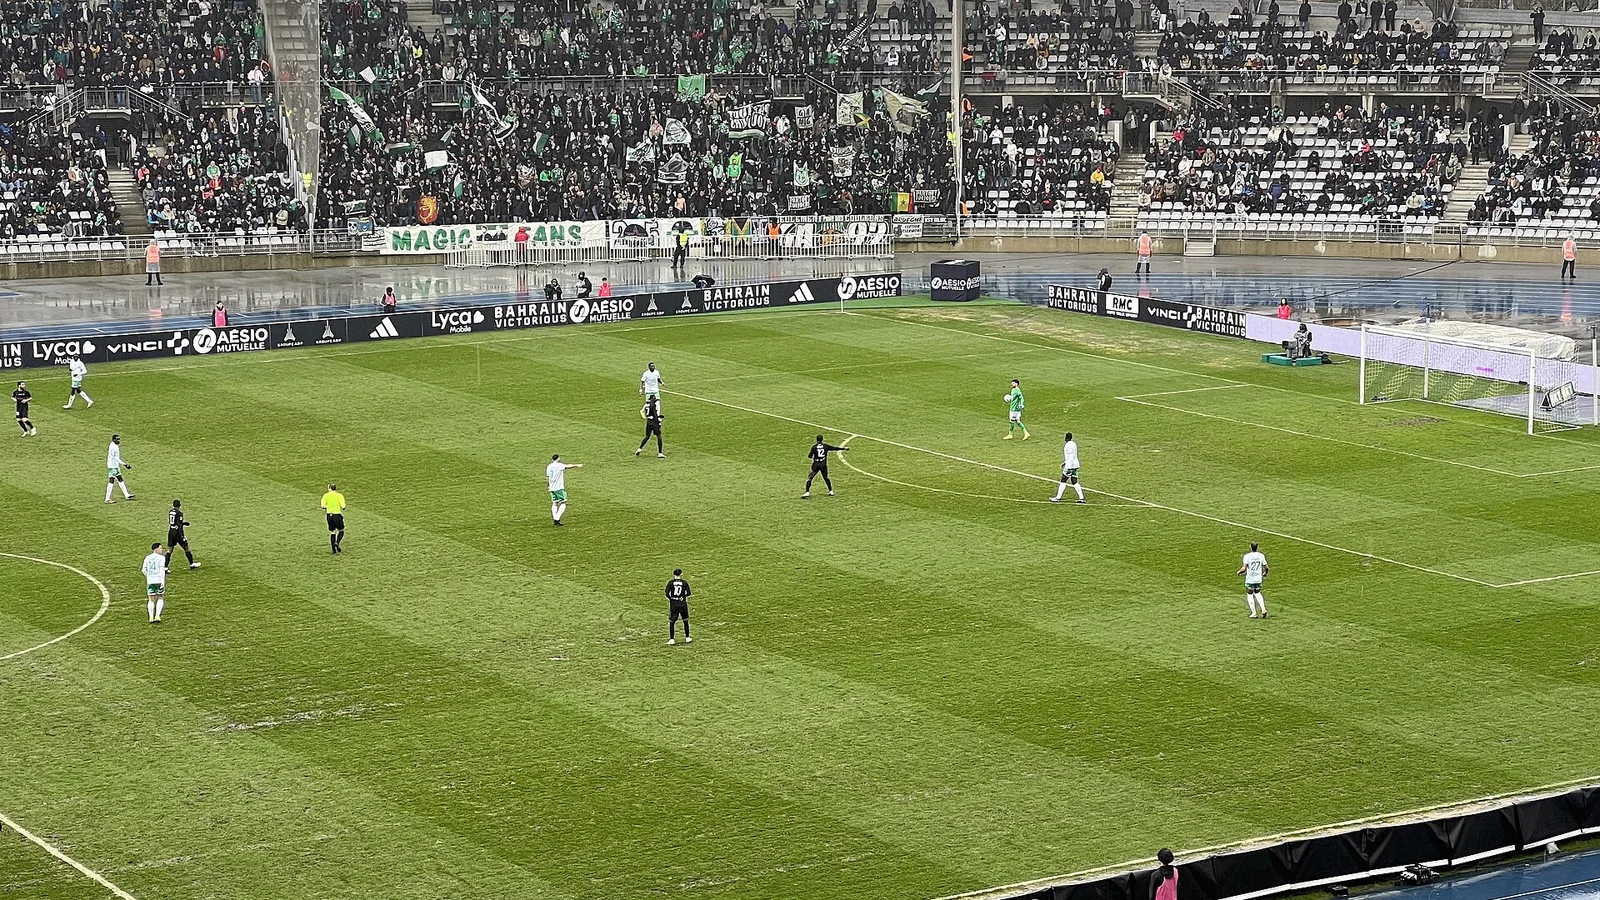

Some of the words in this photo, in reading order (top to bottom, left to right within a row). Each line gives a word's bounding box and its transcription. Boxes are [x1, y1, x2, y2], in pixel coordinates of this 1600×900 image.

[392, 228, 471, 251] MAGIC
[857, 276, 900, 291] AÉSIO
[703, 285, 770, 301] BAHRAIN
[856, 289, 897, 299] MUTUELLE
[1048, 285, 1098, 304] BAHRAIN
[494, 301, 567, 319] BAHRAIN
[590, 299, 634, 315] AÉSIO
[703, 297, 770, 311] VICTORIOUS
[1048, 298, 1098, 313] VICTORIOUS
[1113, 297, 1133, 310] RMC
[432, 311, 472, 330] Lyca
[494, 314, 567, 328] VICTORIOUS
[590, 312, 632, 322] MUTUELLE
[1147, 306, 1181, 321] VINCI
[1196, 306, 1246, 326] BAHRAIN
[217, 328, 268, 344] AÉSIO
[449, 324, 472, 334] Mobile
[1196, 320, 1246, 337] VICTORIOUS
[33, 341, 80, 361] Lyca
[107, 340, 162, 353] VINCI
[217, 341, 265, 352] MUTUELLE
[817, 448, 825, 458] 12
[1251, 561, 1260, 571] 27
[673, 585, 682, 596] 10
